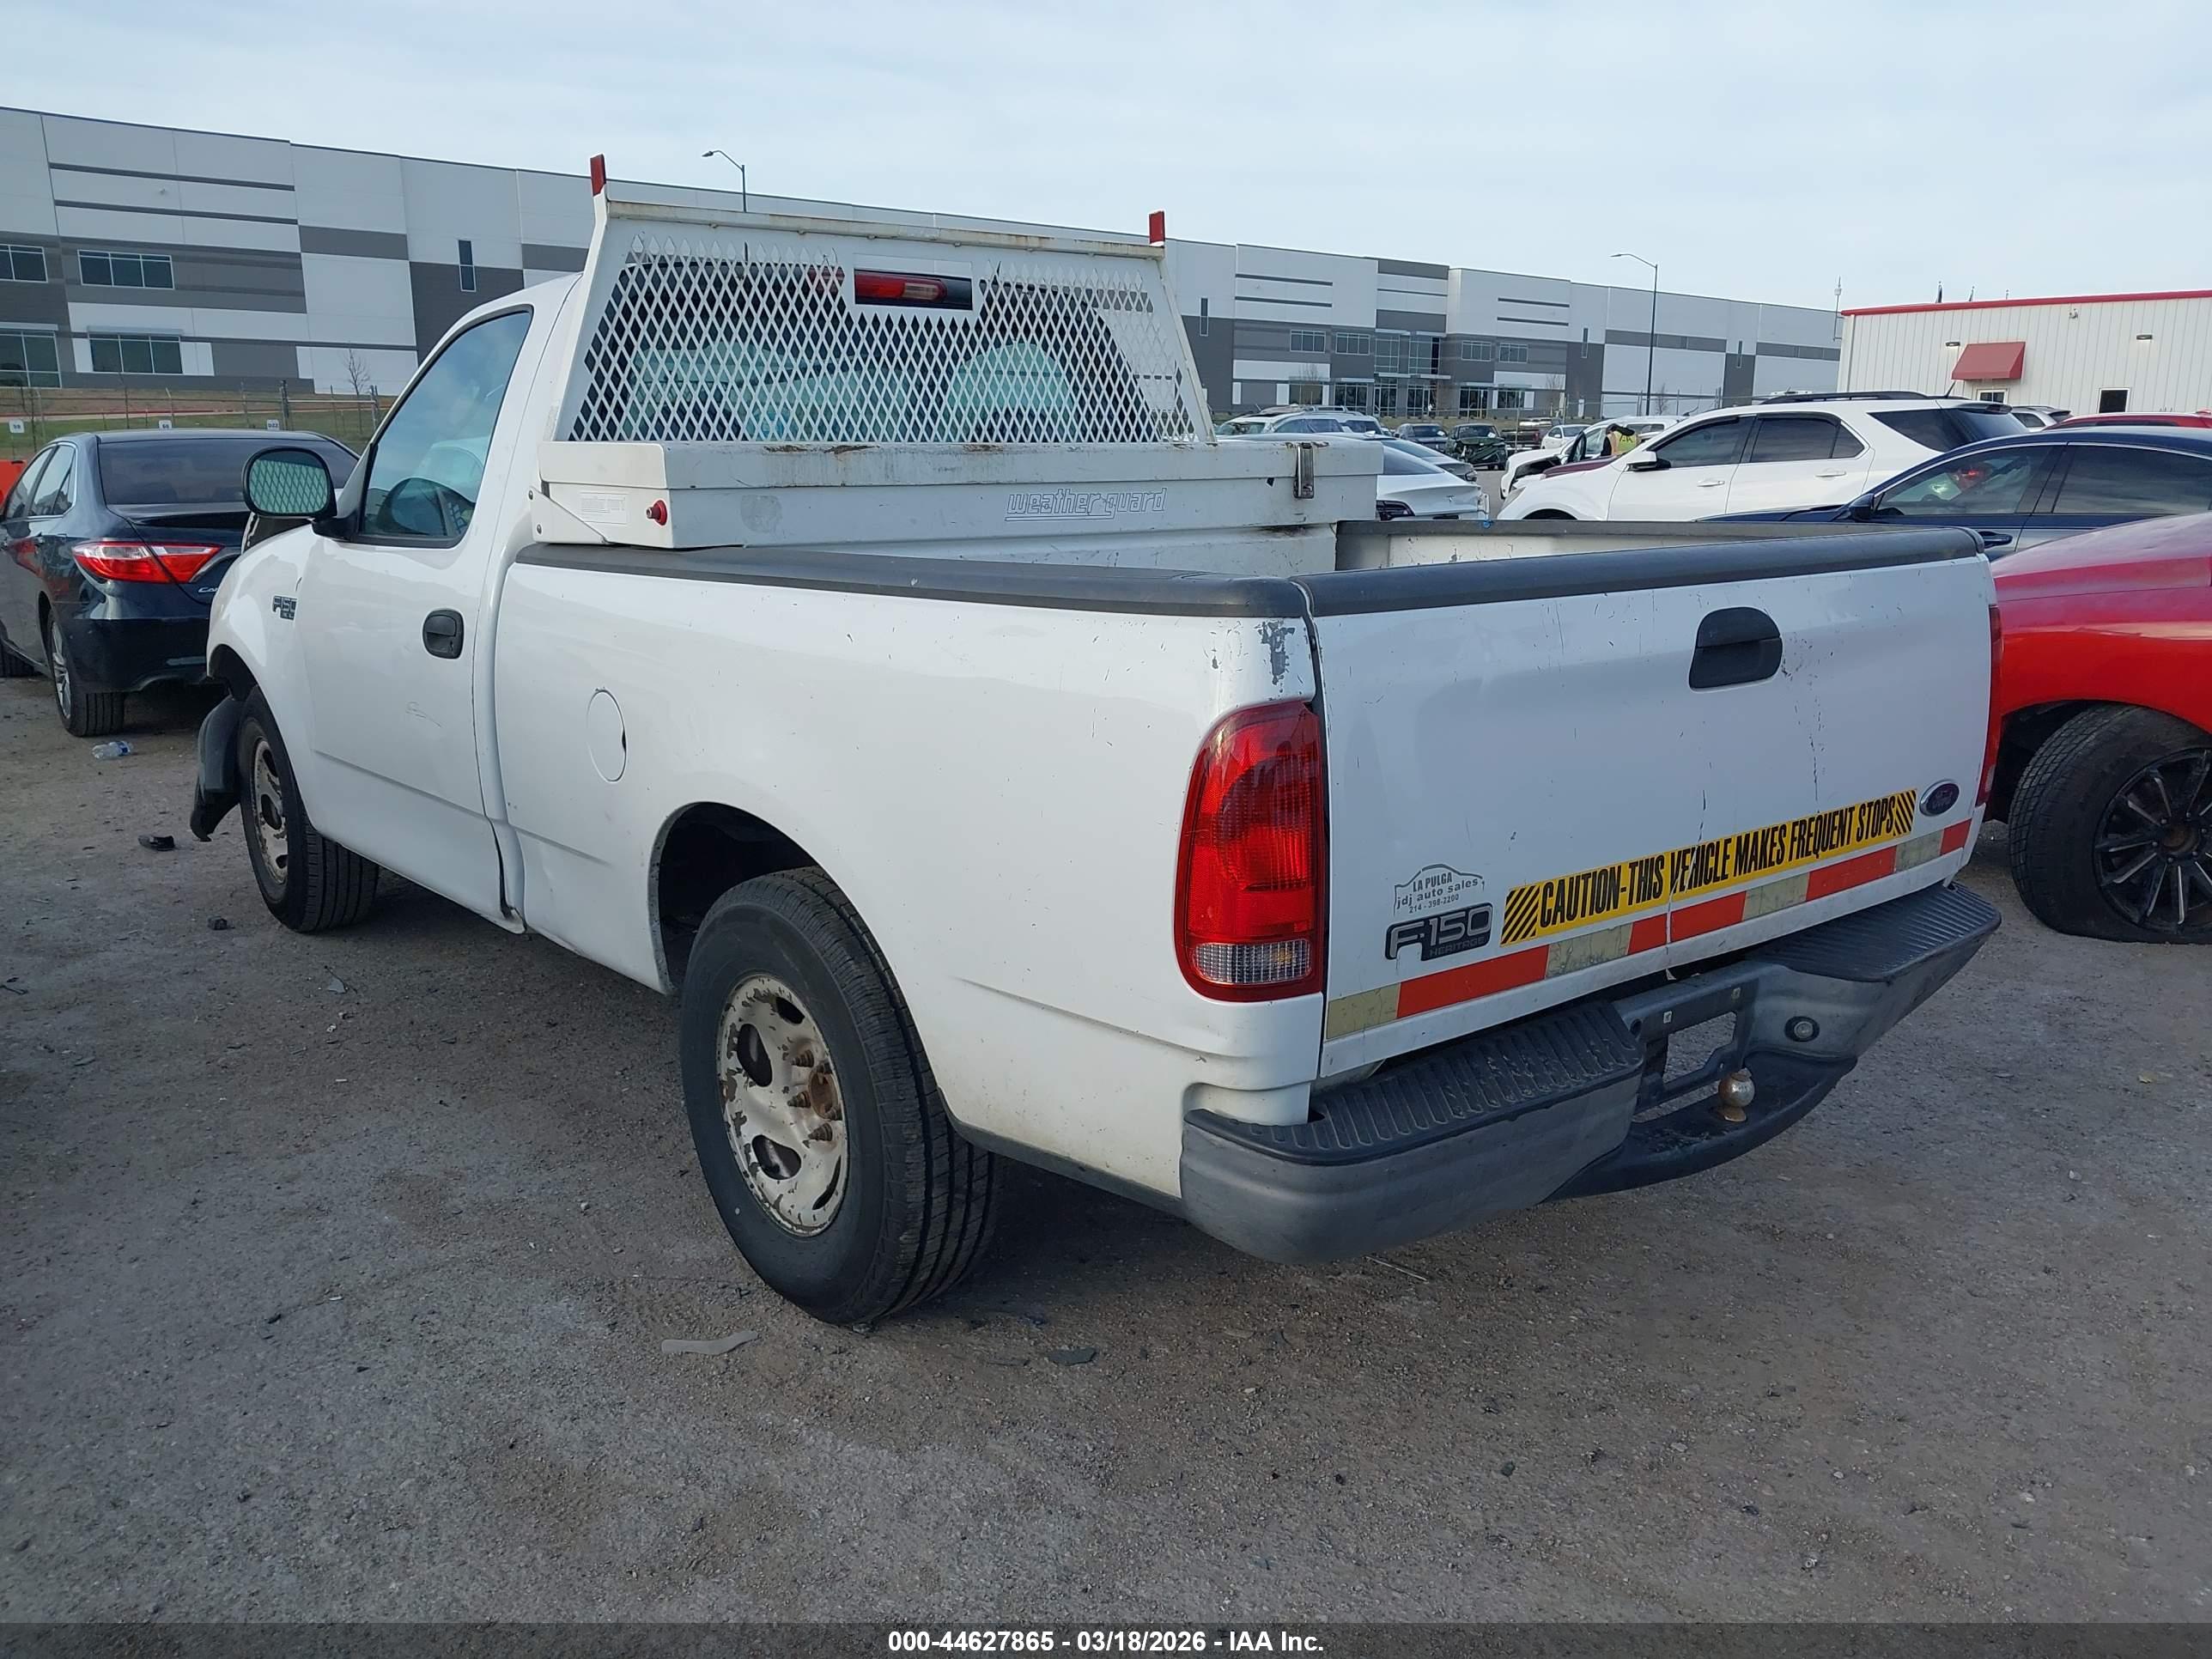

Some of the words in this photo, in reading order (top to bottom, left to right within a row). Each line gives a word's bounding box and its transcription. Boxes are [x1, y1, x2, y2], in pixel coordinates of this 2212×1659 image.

[1669, 837, 1732, 895] VEHICLE
[1733, 823, 1787, 878] MAKES
[1789, 805, 1856, 861] FREQUENT
[1856, 795, 1896, 843] STOPS
[1396, 894, 1413, 909] jdj
[1417, 888, 1443, 902] auto
[1448, 878, 1479, 894] sales
[1413, 879, 1423, 893] LA
[1425, 872, 1452, 890] PULGA
[1430, 937, 1486, 957] HERITAGE
